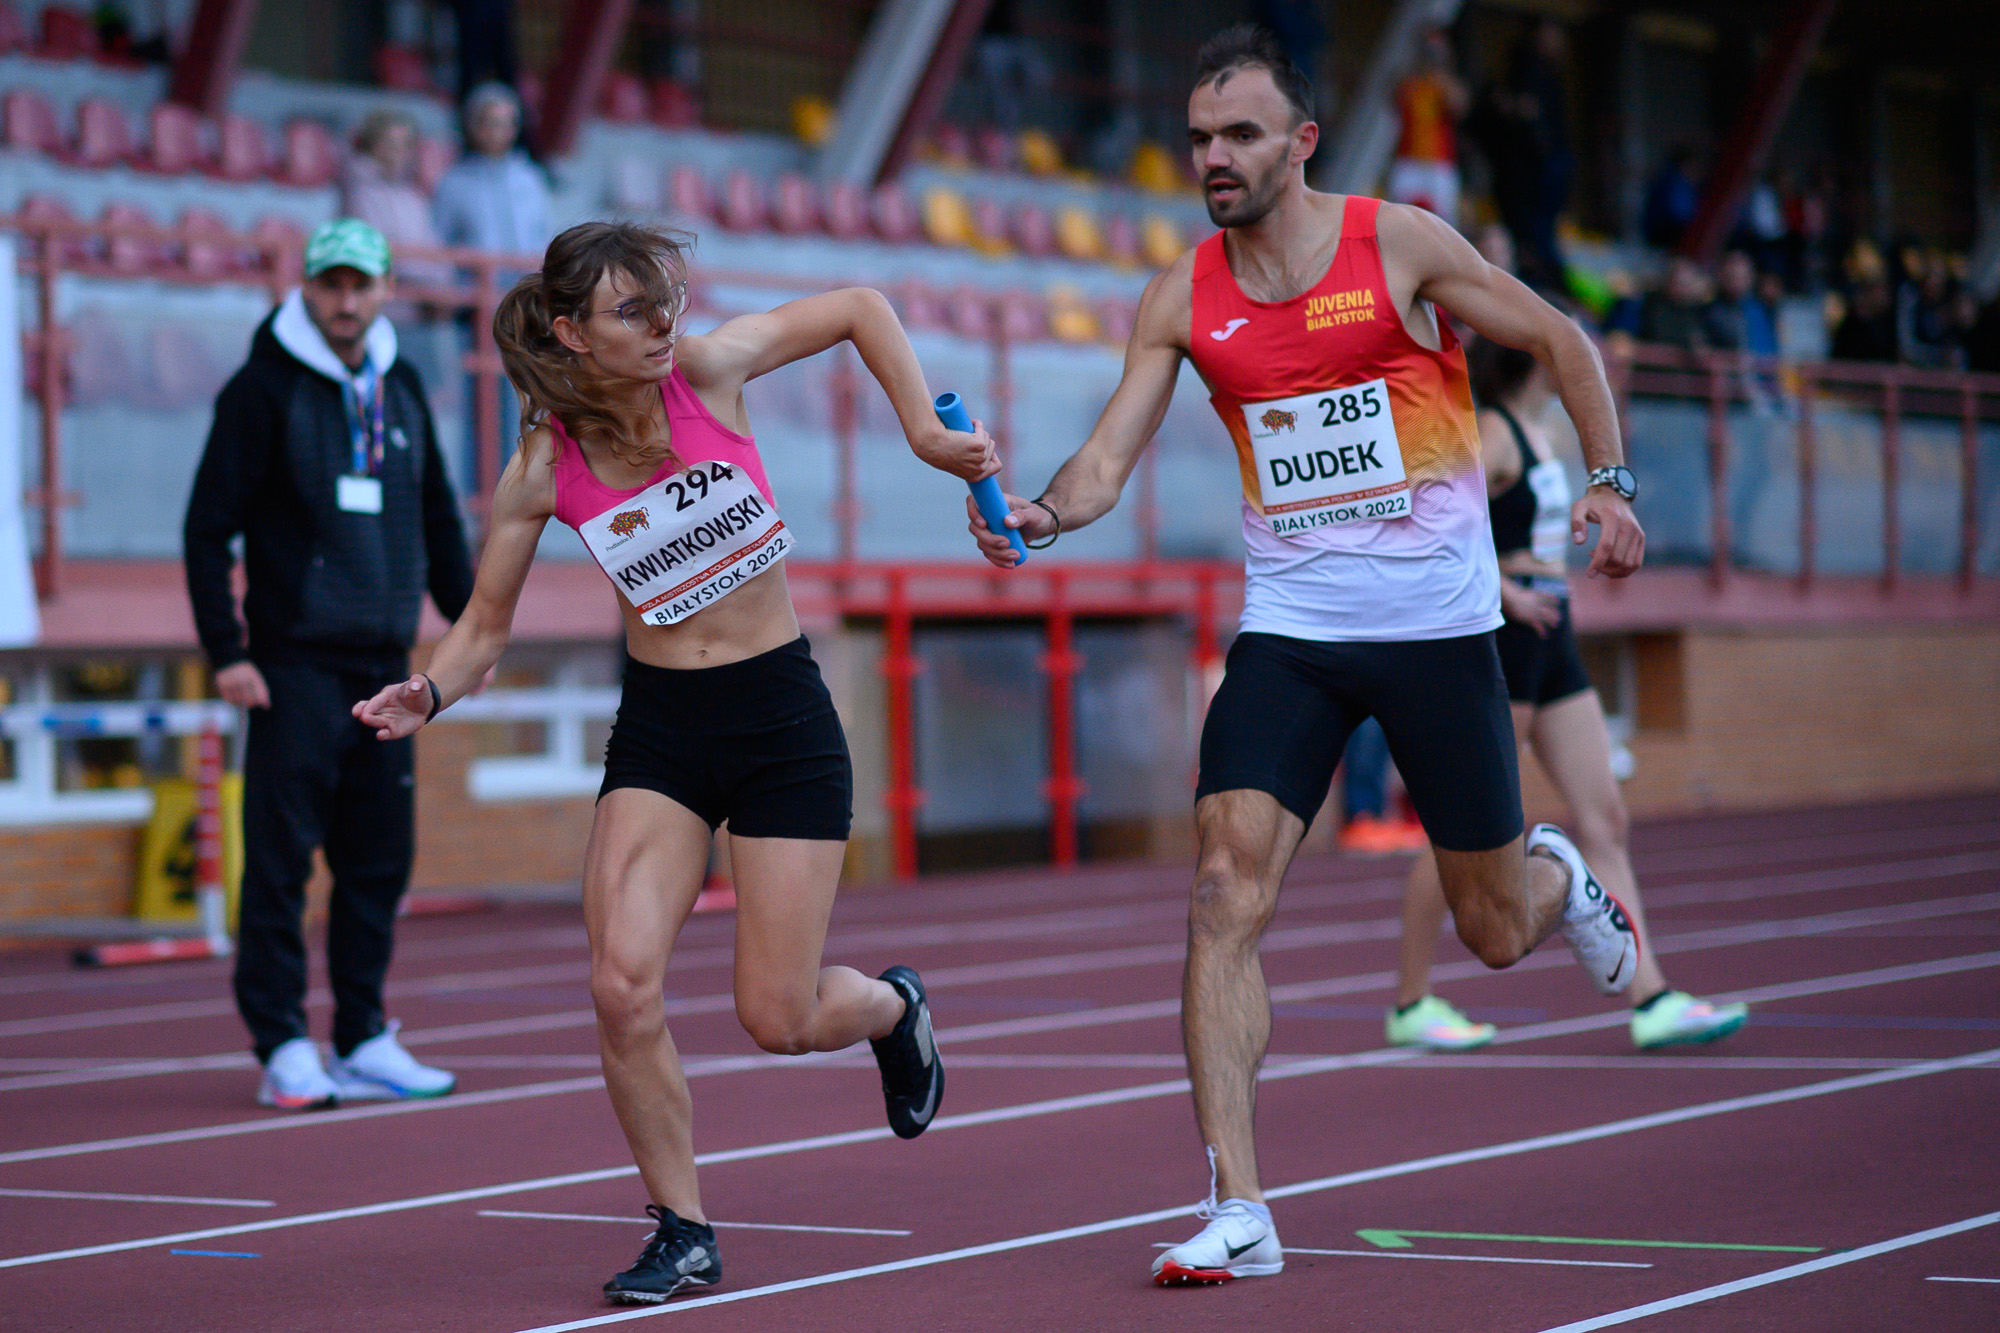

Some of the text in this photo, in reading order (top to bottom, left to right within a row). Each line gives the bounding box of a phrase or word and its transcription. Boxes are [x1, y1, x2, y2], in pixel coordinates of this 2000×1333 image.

[1305, 289, 1375, 317] JUVENIA
[1306, 308, 1376, 332] BIAŁYSTOK
[1318, 387, 1381, 428] 285
[665, 462, 734, 512] 294
[1269, 440, 1384, 487] DUDEK
[1273, 496, 1407, 533] BIAŁYSTOK 2022
[617, 494, 765, 591] KWIATKOWSKI
[641, 597, 662, 611] PZLA
[661, 571, 711, 601] MISTRZOSTWA
[709, 555, 735, 574] POLSKI
[655, 538, 788, 625] BIAŁYSTOK 2022
